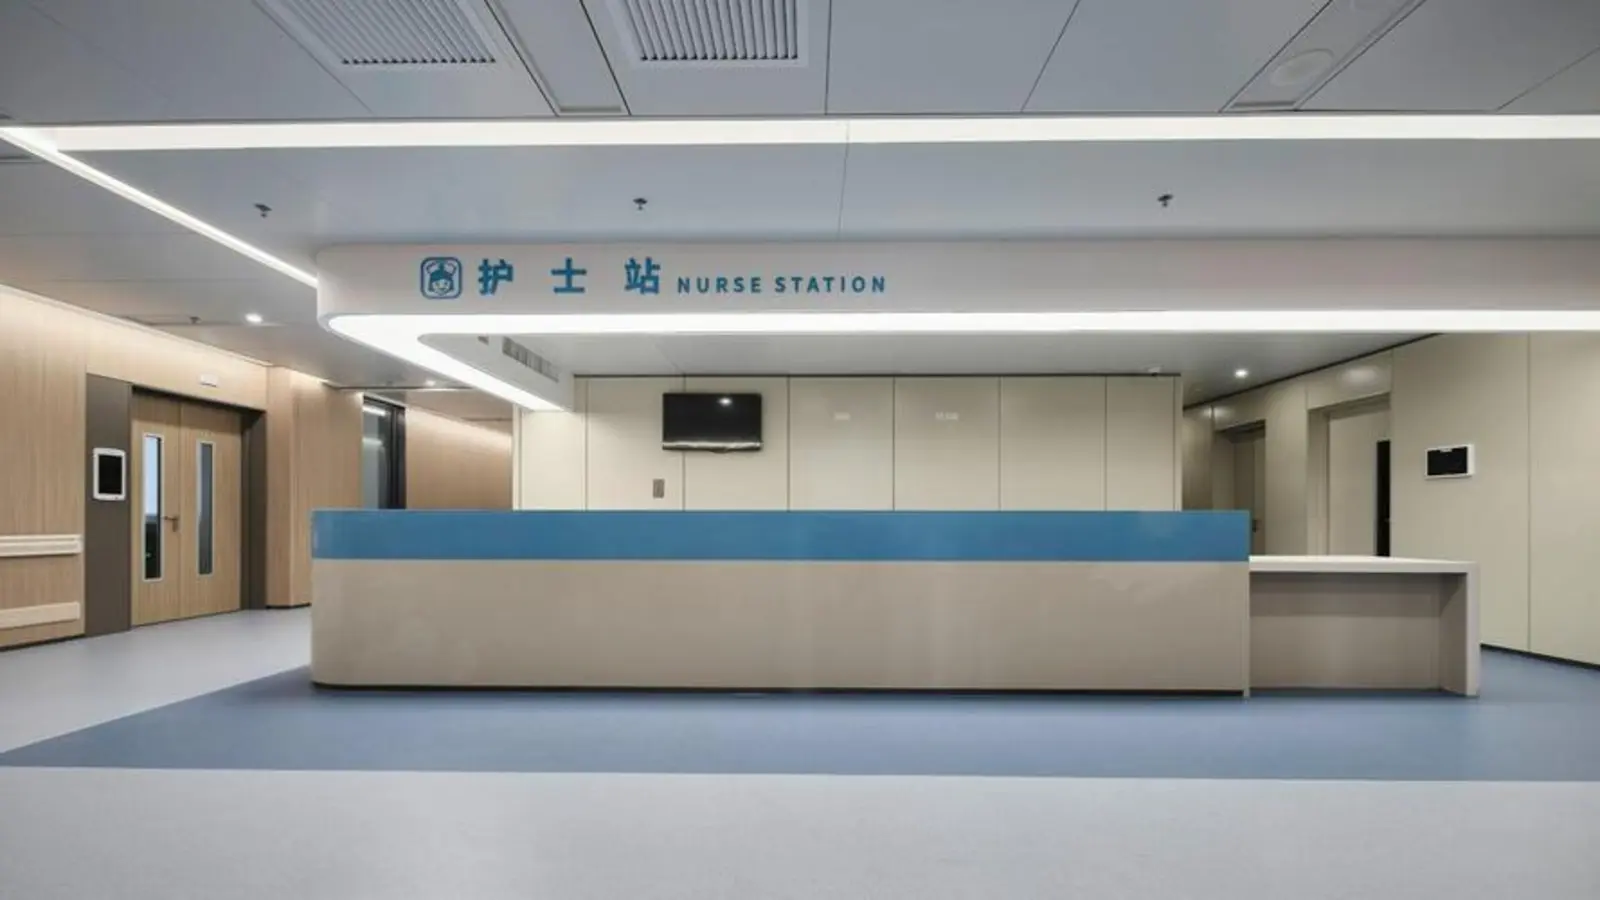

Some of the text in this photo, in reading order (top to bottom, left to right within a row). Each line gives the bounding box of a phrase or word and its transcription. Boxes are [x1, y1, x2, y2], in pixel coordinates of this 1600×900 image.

[478, 257, 887, 295] 护士站 NURSE STATION
